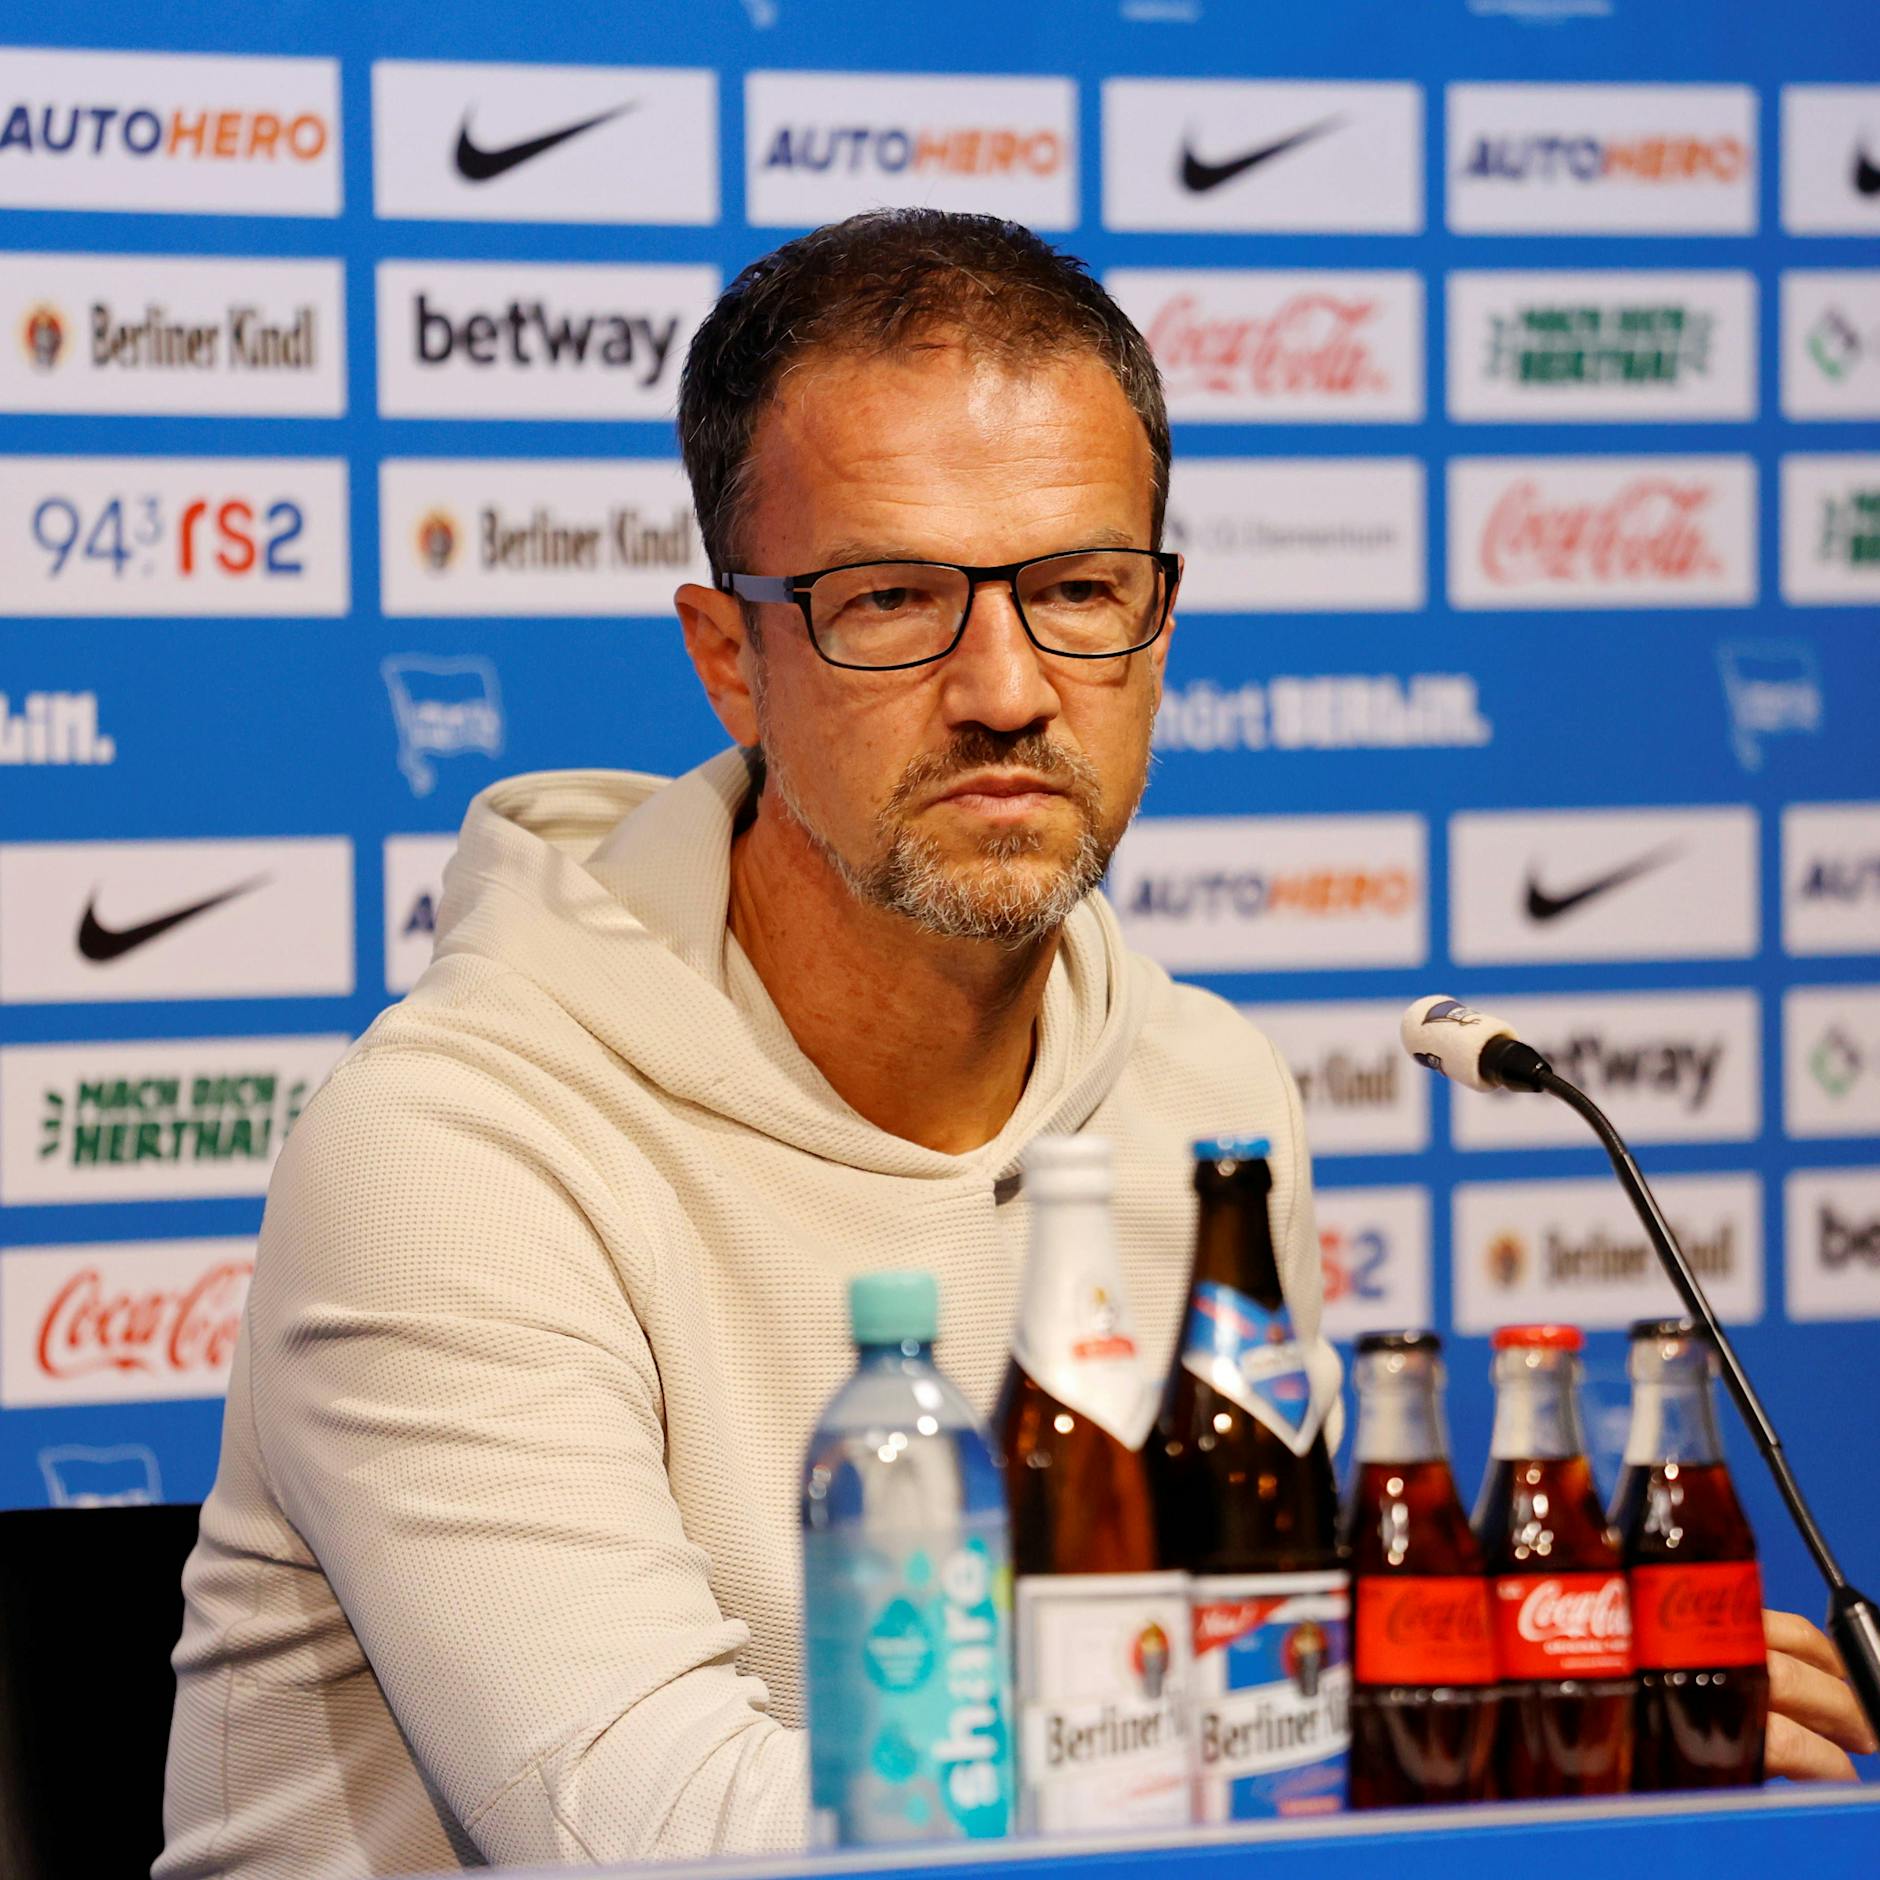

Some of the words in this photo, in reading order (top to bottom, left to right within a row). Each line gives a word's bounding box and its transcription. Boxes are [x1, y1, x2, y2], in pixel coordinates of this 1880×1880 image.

[0, 106, 327, 160] AUTOHERO
[766, 127, 1061, 176] AUTOHERO
[91, 302, 219, 369] Berliner
[228, 305, 314, 370] Kindl
[414, 295, 677, 388] betway
[481, 508, 602, 570] Berliner
[608, 508, 691, 568] Kindl
[1129, 867, 1412, 918] AUTOHERO
[933, 1551, 999, 1808] share
[1047, 1705, 1163, 1766] Berliner
[1201, 1701, 1321, 1763] Berliner
